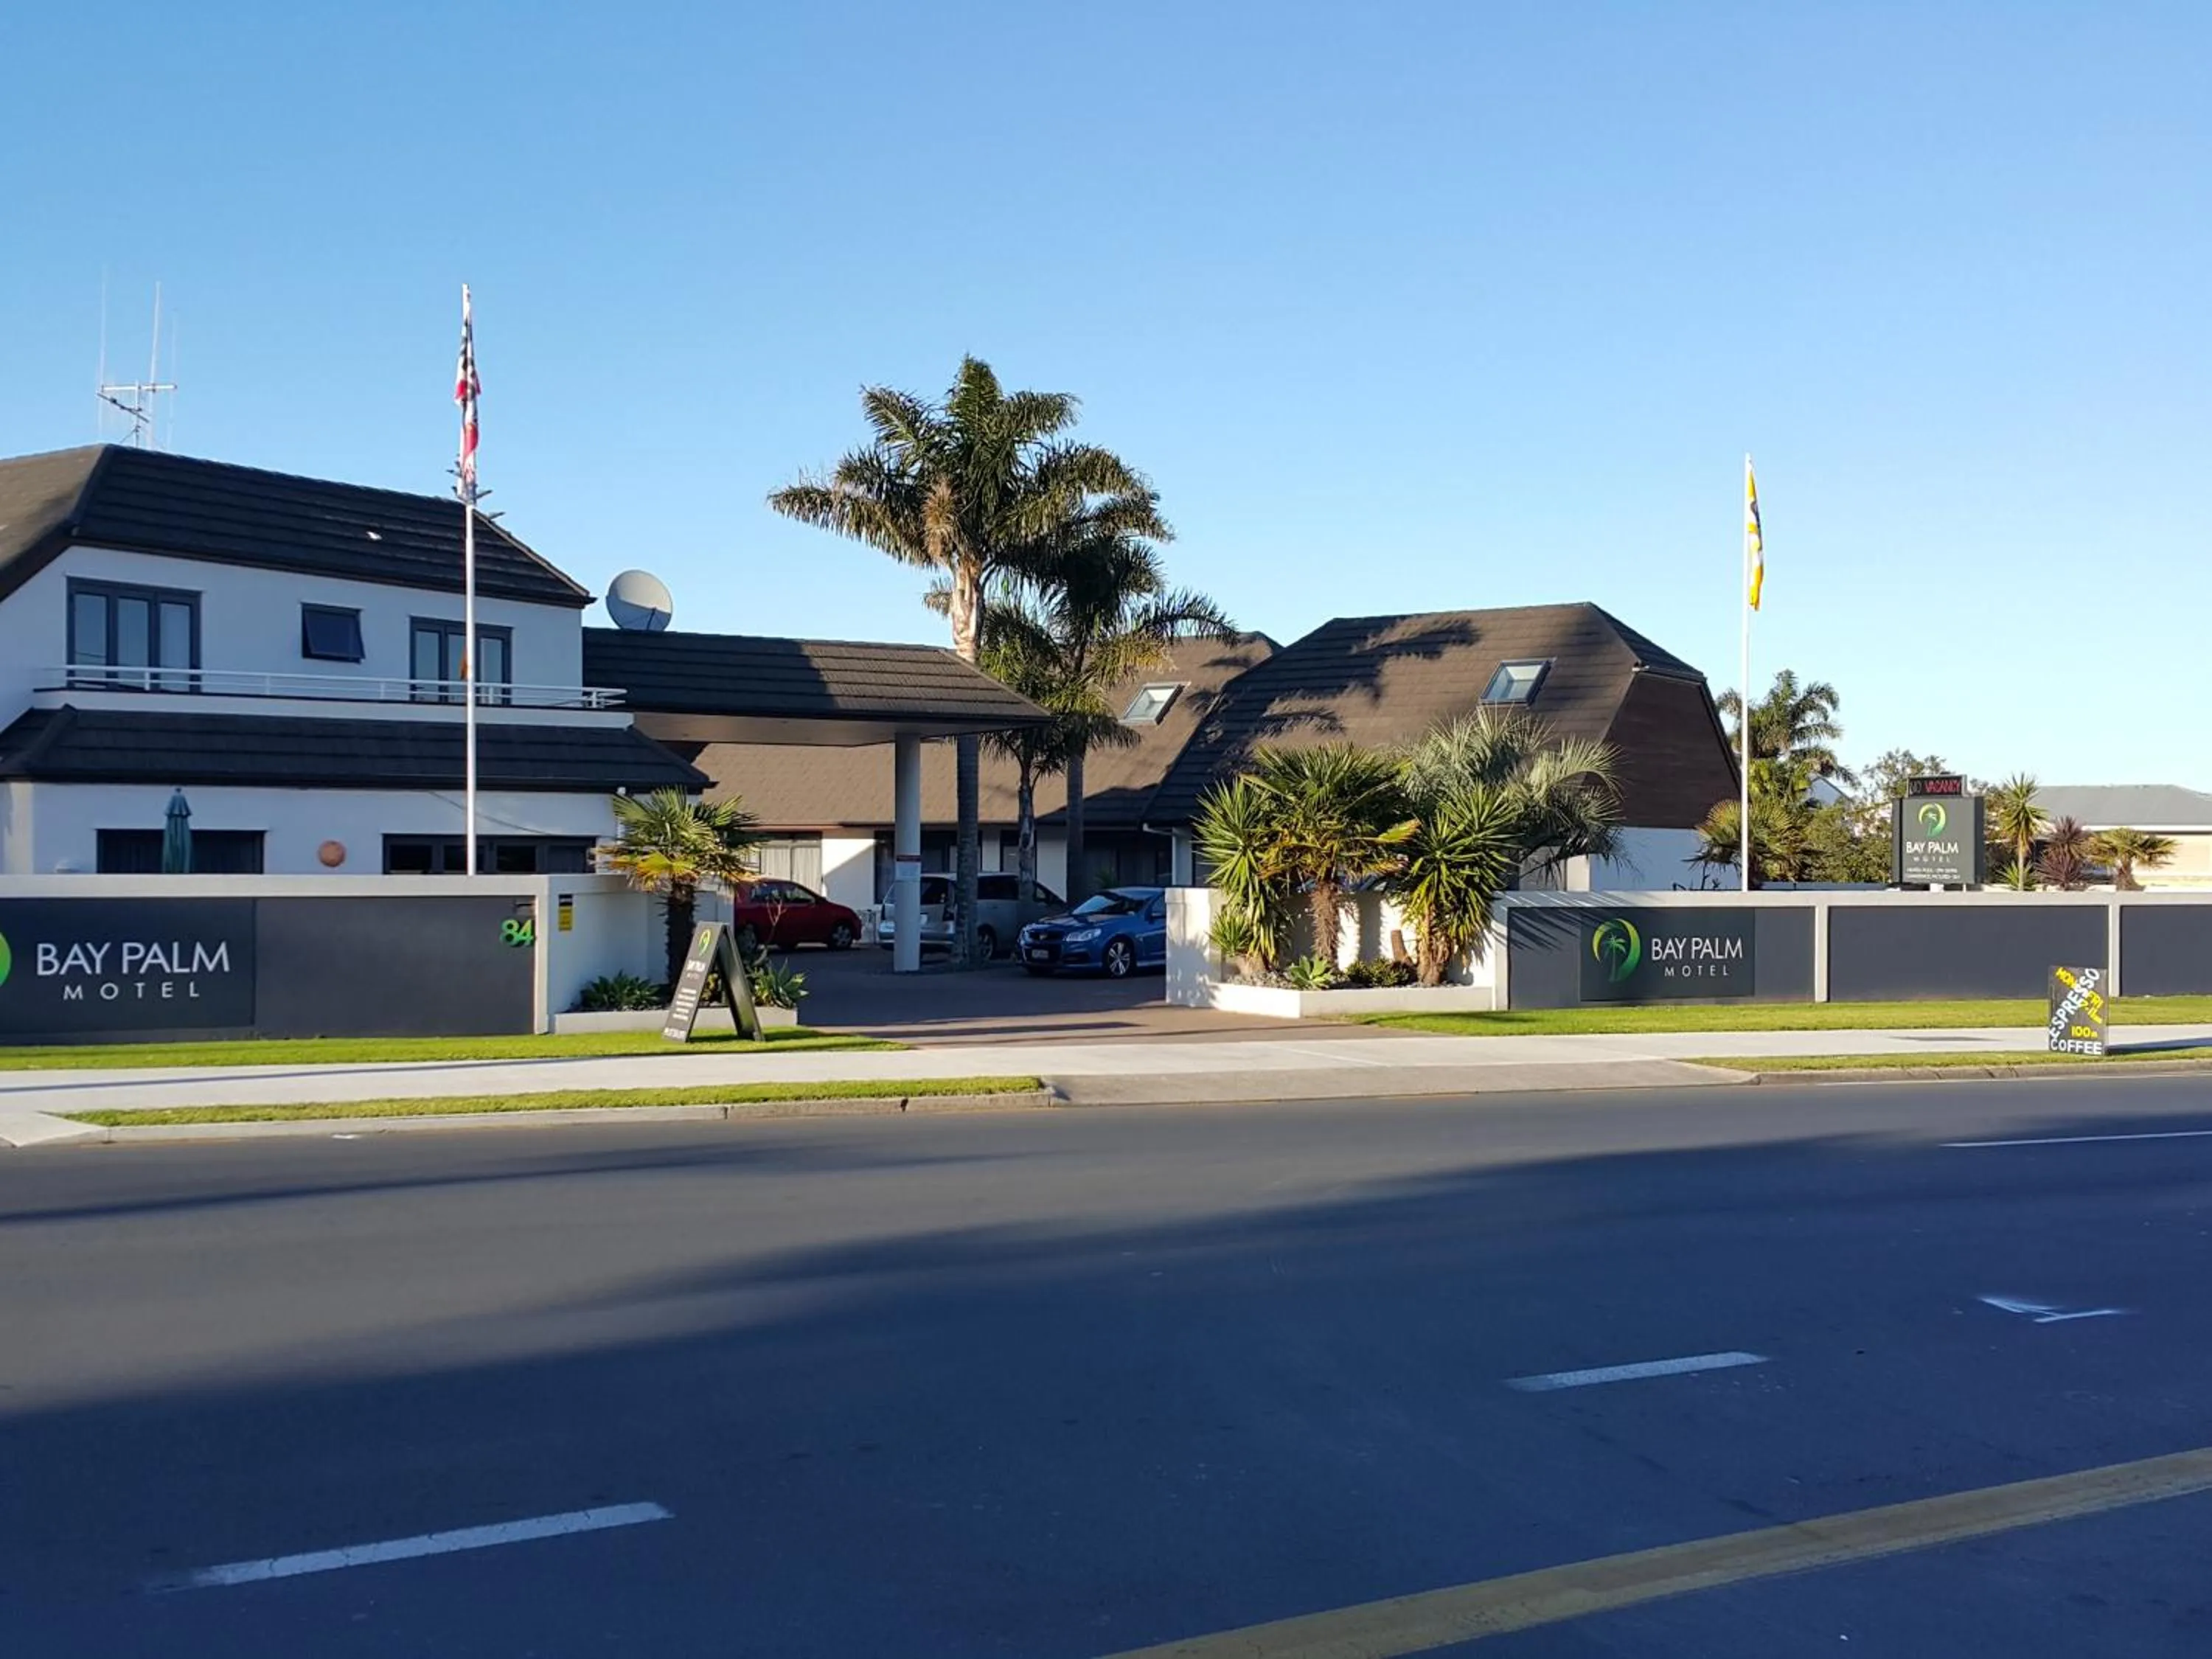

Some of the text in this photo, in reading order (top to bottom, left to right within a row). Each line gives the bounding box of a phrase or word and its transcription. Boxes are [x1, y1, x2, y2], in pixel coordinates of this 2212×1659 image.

[1906, 841, 1959, 855] BAY PALM
[498, 919, 535, 947] 84
[37, 941, 231, 976] BAY PALM
[1651, 936, 1743, 961] BAY PALM
[1663, 964, 1730, 978] MOTEL
[63, 981, 200, 1001] MOTEL
[2049, 968, 2101, 1039] ESPRESSO
[2050, 1038, 2103, 1055] COFFEE
